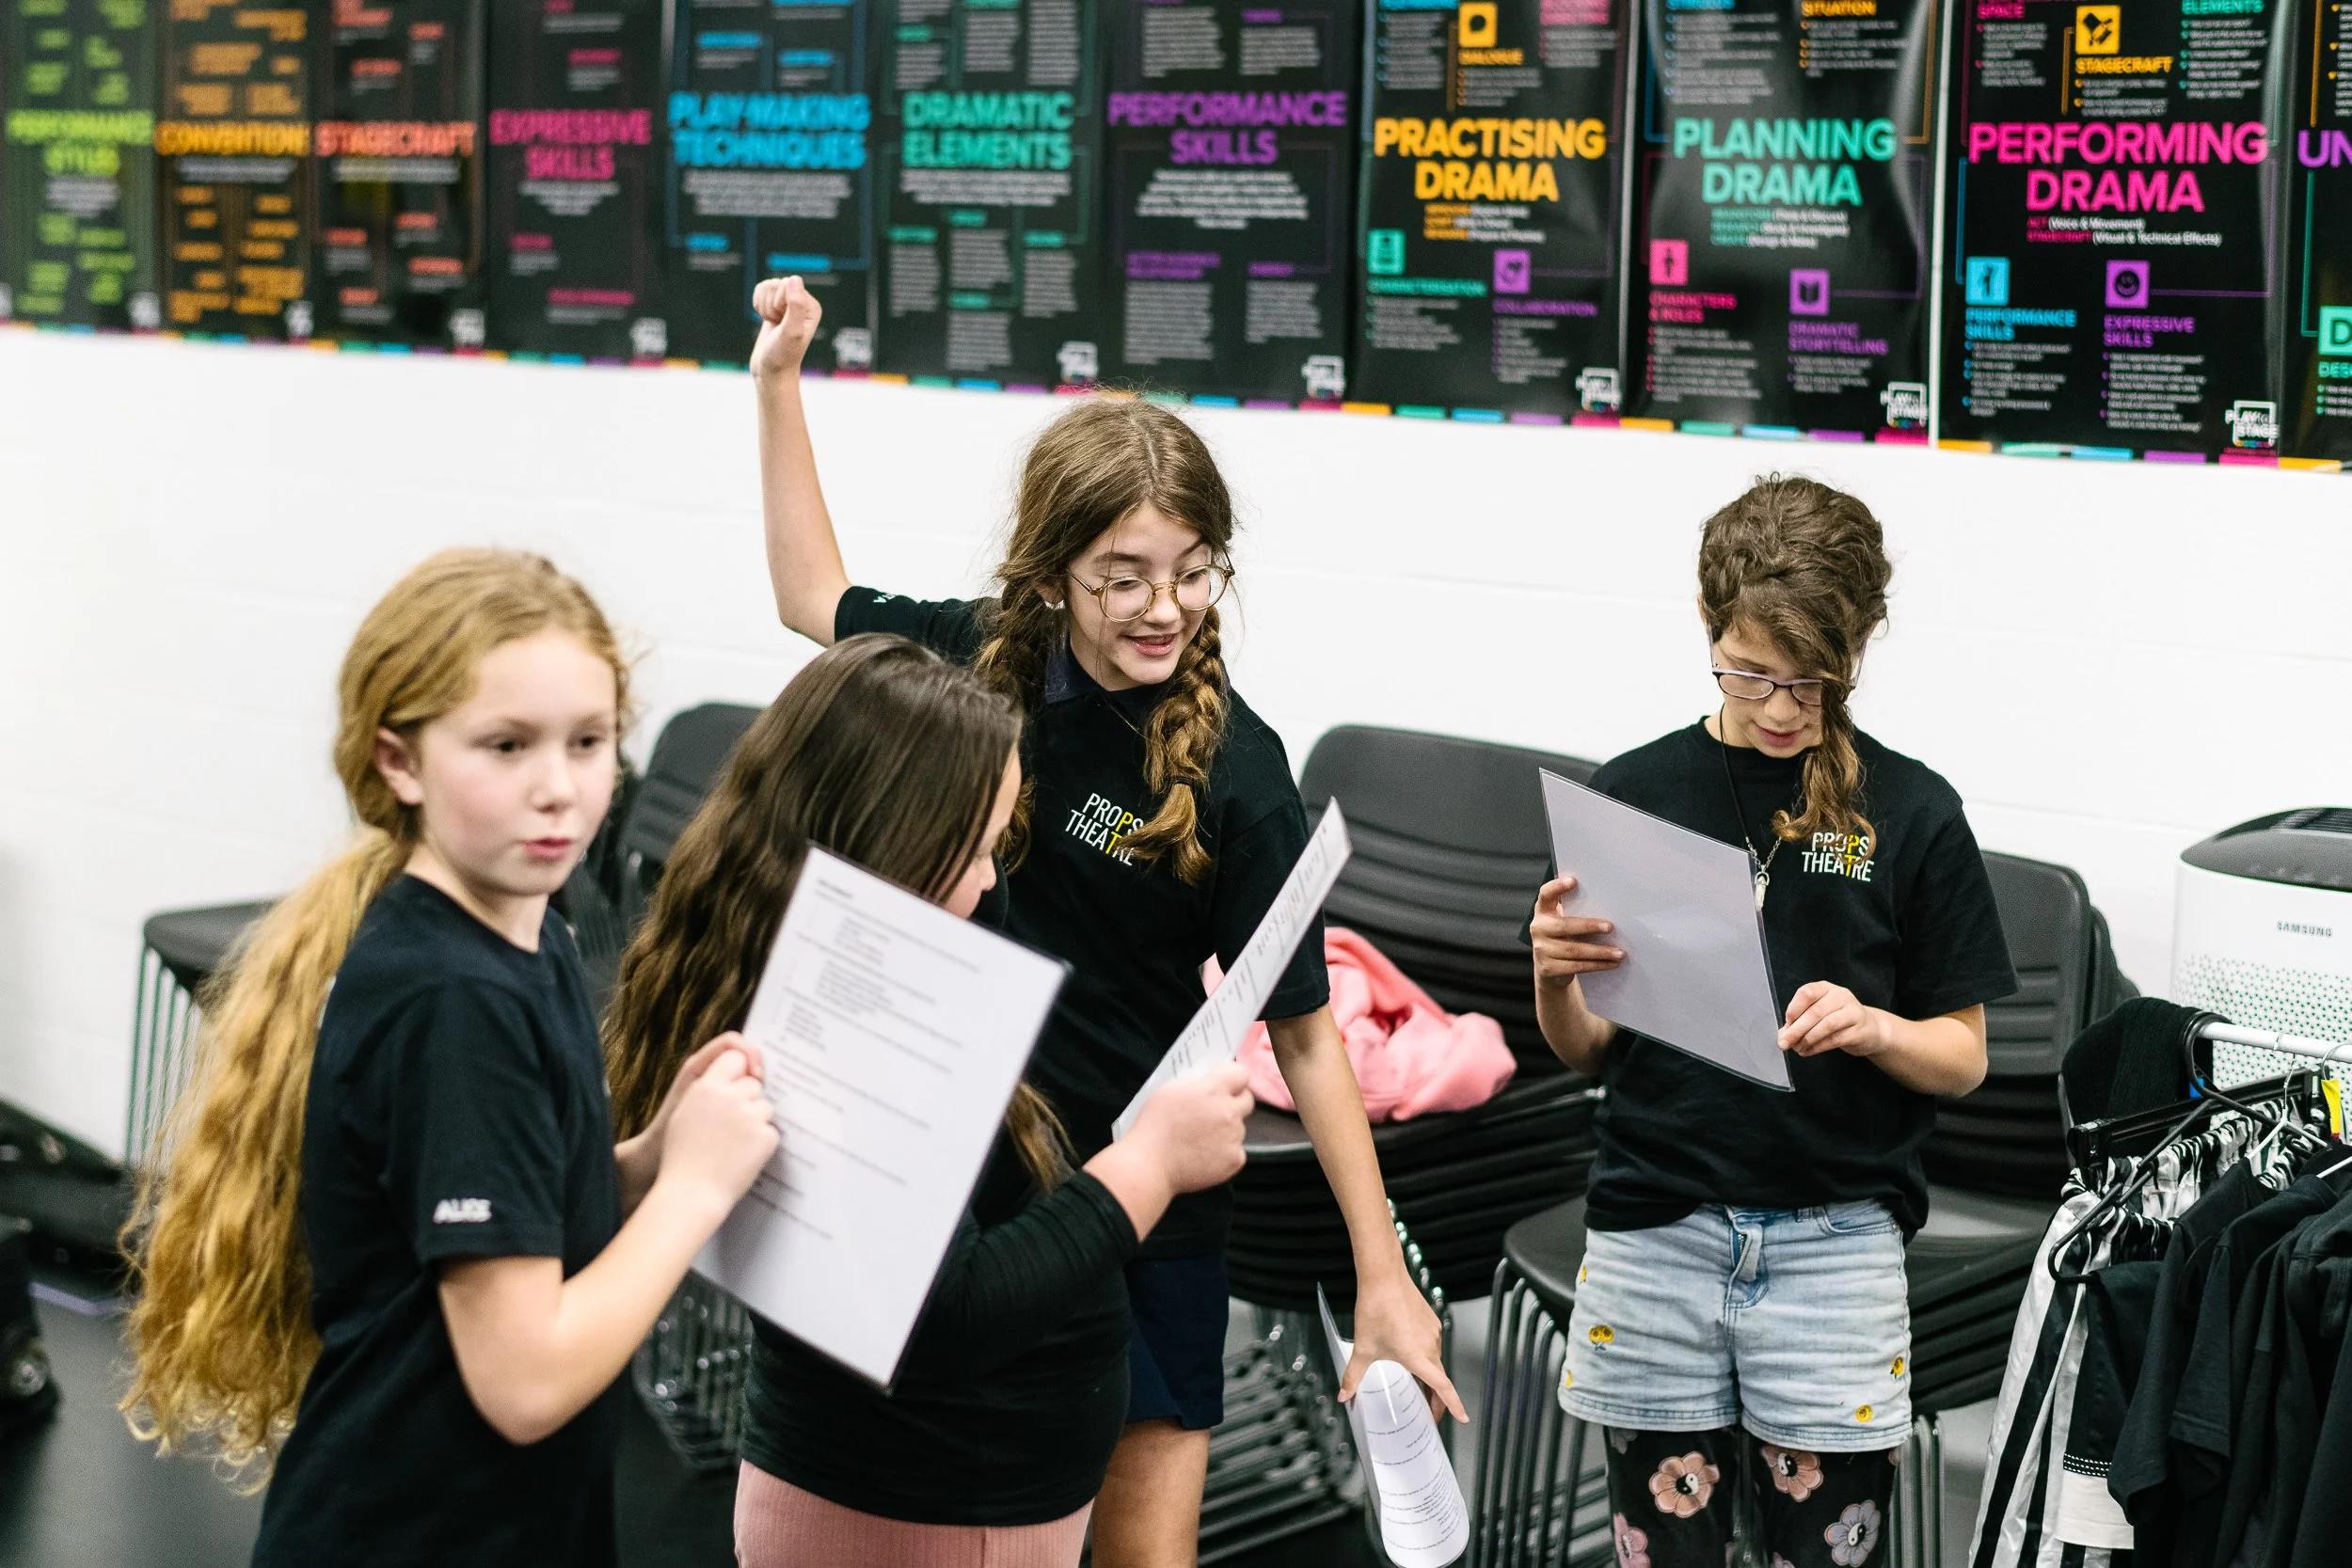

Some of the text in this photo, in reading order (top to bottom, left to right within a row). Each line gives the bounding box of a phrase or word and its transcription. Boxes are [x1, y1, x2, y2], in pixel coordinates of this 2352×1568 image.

[1978, 4, 2025, 19] SPACE
[2182, 0, 2265, 14] ELEMENTS
[2075, 56, 2173, 74] STAGECRAFT
[669, 91, 871, 131] PLAYMAKING
[901, 91, 1073, 129] DRAMATIC
[1108, 91, 1346, 126] PERFORMANCE
[315, 120, 477, 156] STAGECRAFT
[488, 109, 652, 145] EXPRESSIVE
[1374, 117, 1607, 159] PRACTISING
[1673, 118, 1897, 161] PLANNING
[1968, 121, 2268, 165] PERFORMING
[523, 146, 614, 181] SKILLS
[672, 130, 866, 169] TECHNIQUES
[901, 130, 1072, 168] ELEMENTS
[1170, 130, 1278, 164] SKILLS
[2297, 129, 2352, 167] UN
[1414, 160, 1560, 202] DRAMA
[1701, 163, 1864, 206] DRAMA
[2026, 169, 2205, 213] DRAMA
[1788, 321, 1860, 339] DRAMATIC
[1965, 308, 2077, 327] PERFORMANCE
[1965, 323, 2014, 341] SKILLS
[2104, 315, 2195, 333] EXPRESSIVE
[1788, 338, 1889, 356] STORYTELLING
[2104, 331, 2153, 347] SKILLS
[1083, 792, 1144, 835] PROPS
[1812, 832, 1869, 856] PROPS
[1802, 851, 1874, 882] THEATRE
[2277, 921, 2331, 938] SAMSUNG
